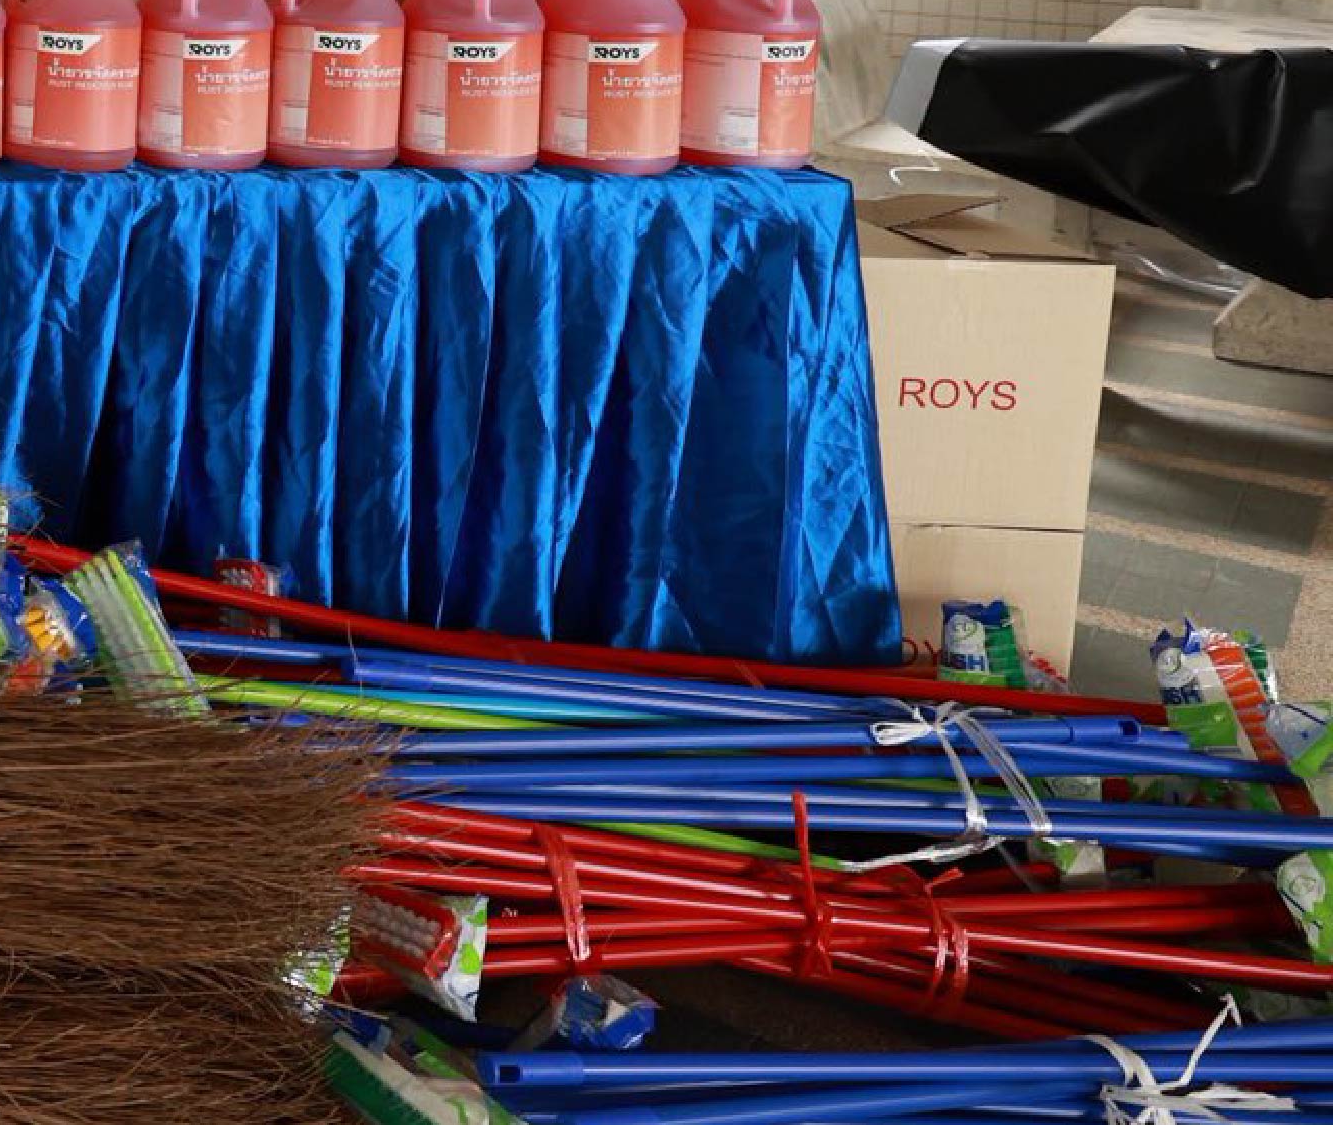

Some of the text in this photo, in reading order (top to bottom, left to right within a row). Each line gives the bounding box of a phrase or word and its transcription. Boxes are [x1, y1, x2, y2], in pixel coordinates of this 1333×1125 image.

[42, 35, 84, 51] ROYS
[188, 43, 230, 56] ROYS
[318, 36, 361, 51] ROYS
[453, 46, 497, 59] ROYS
[594, 46, 640, 59] ROYS
[767, 44, 807, 59] ROYS
[897, 376, 1018, 411] ROYS
